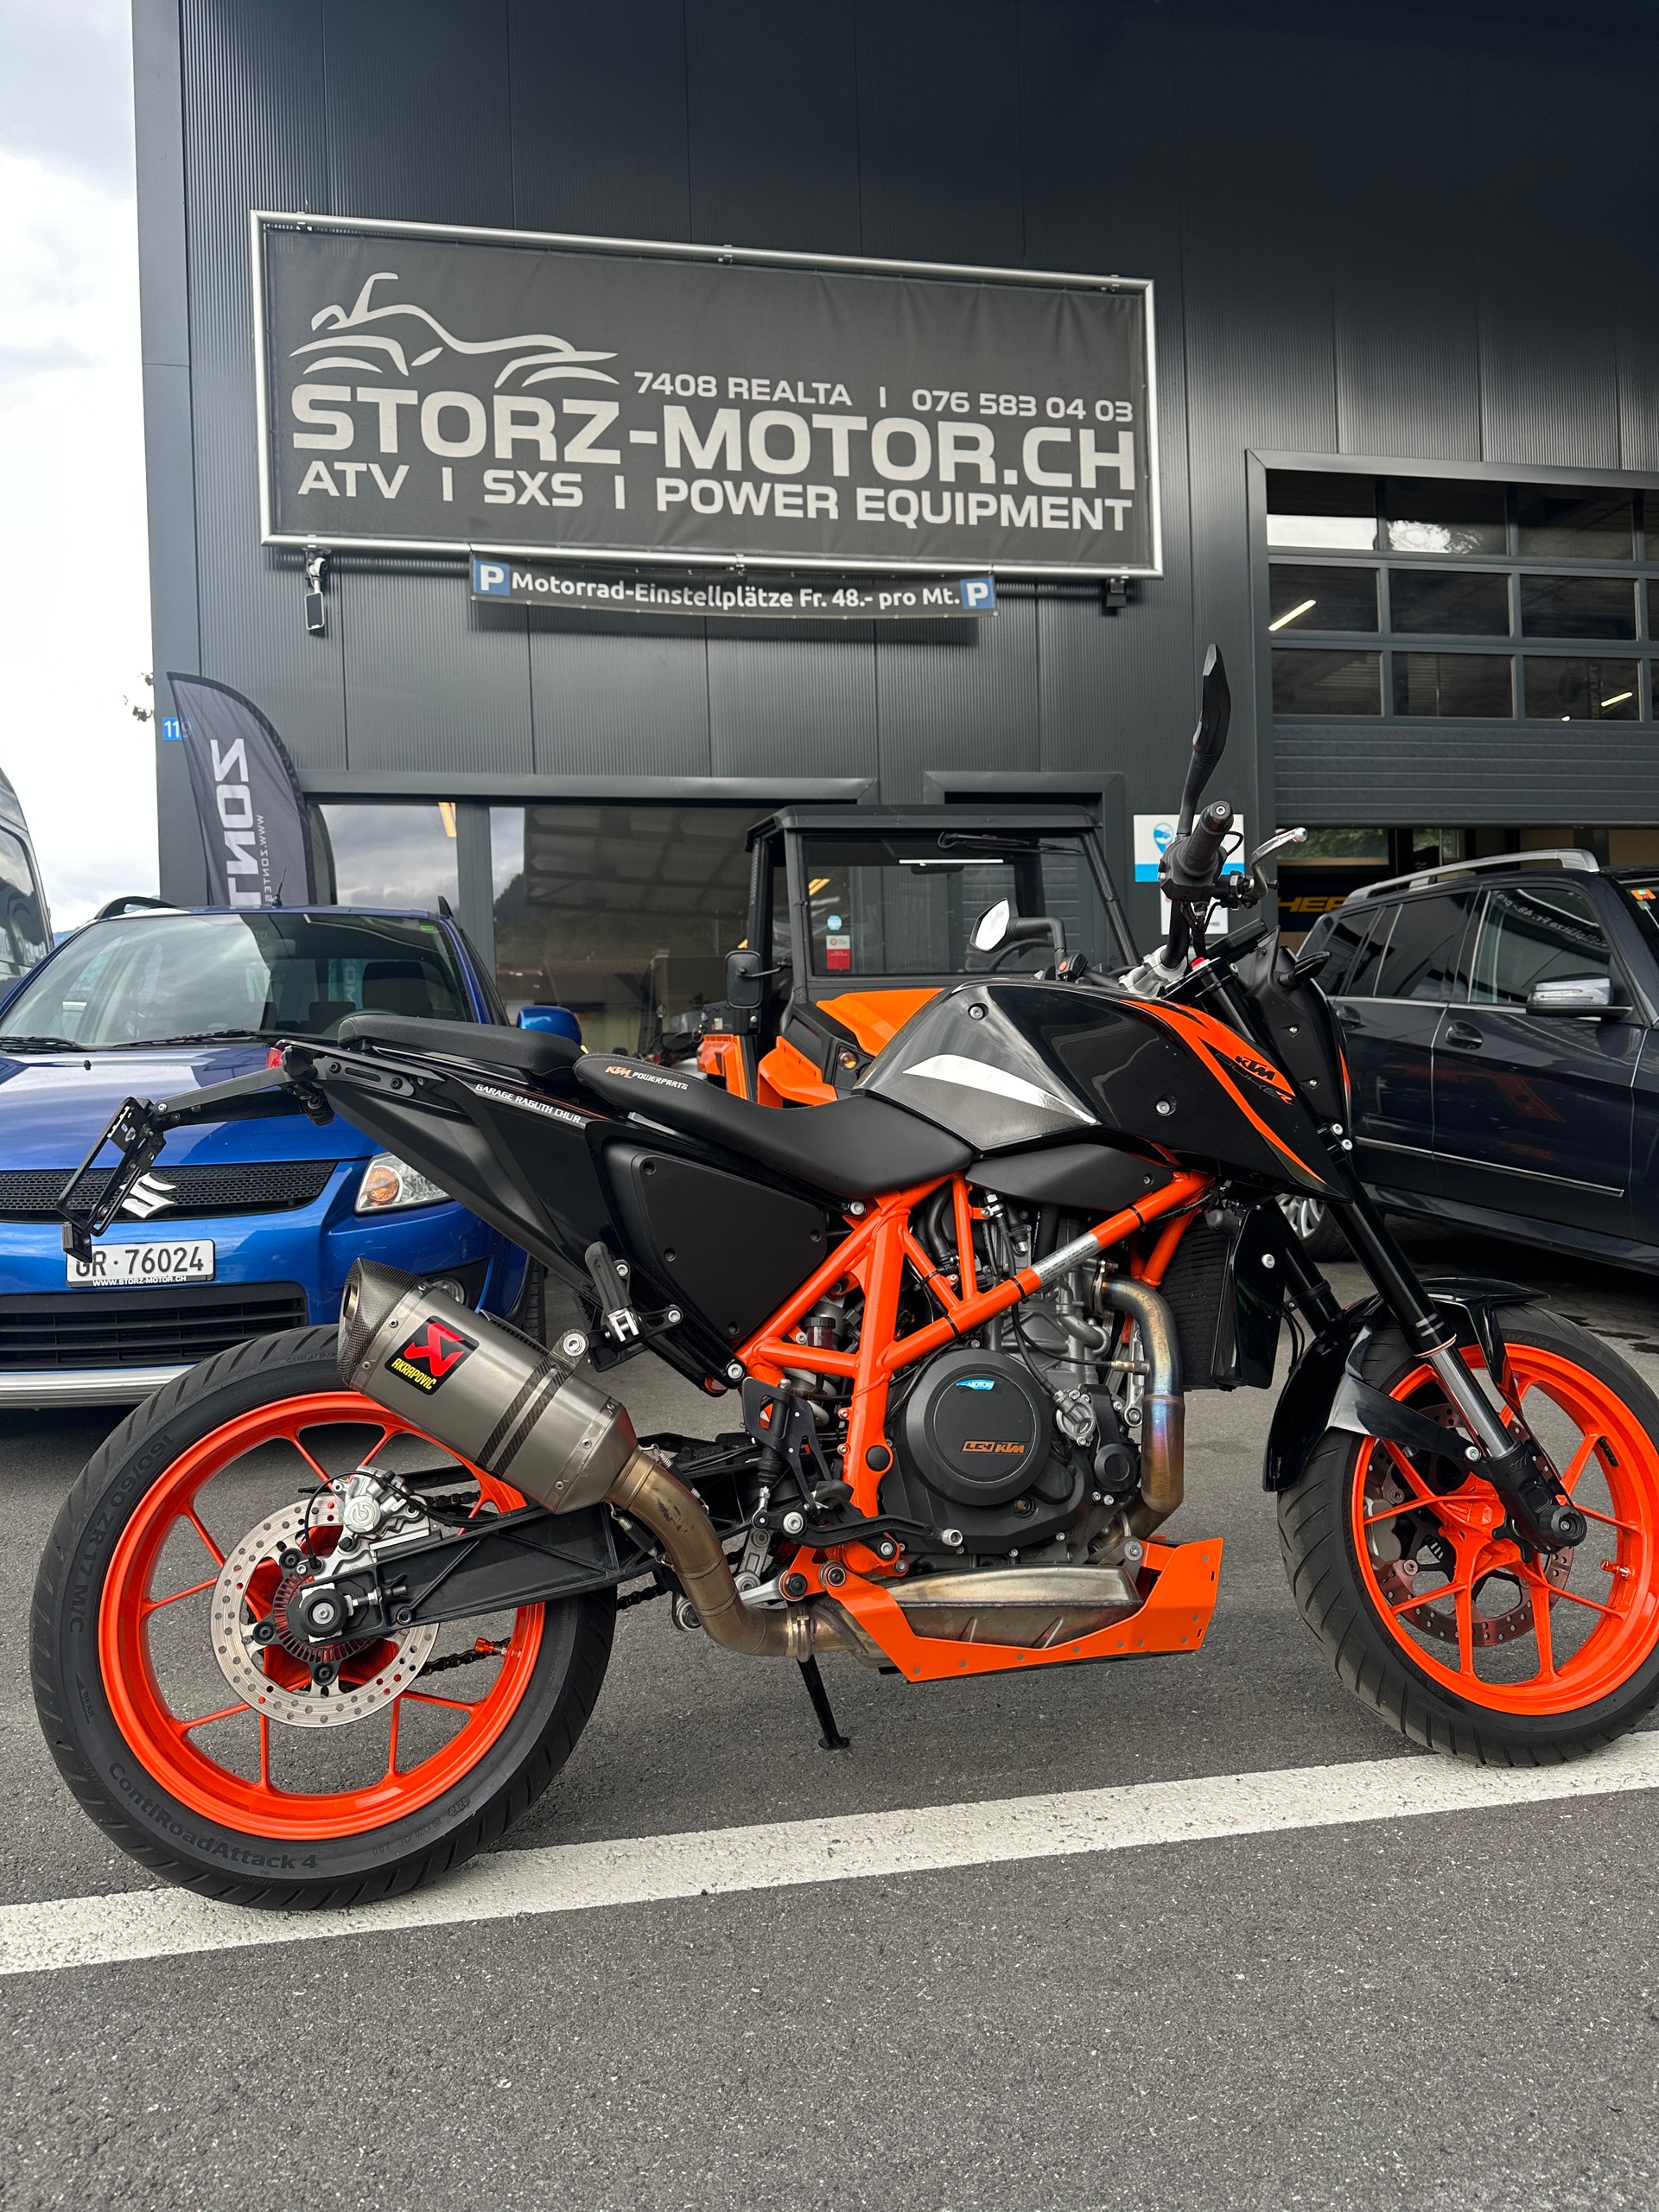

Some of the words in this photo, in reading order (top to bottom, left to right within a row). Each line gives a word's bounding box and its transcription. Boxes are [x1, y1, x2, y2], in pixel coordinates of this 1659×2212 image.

[634, 371, 717, 397] 7408
[728, 377, 853, 406] REALTA
[912, 388, 969, 414] 076
[979, 392, 1037, 416] 583
[1046, 397, 1086, 420] 04
[1094, 400, 1133, 422] 03
[291, 383, 1136, 490] STORZ-MOTOR.CH
[297, 461, 410, 499] ATV
[483, 469, 584, 507] SXS
[657, 477, 839, 520] POWER
[855, 487, 1133, 531] EQUIPMENT
[480, 564, 505, 591] P
[512, 571, 794, 611] Motorrad-Einstellplätze
[799, 588, 828, 607] Fr.
[831, 588, 874, 607] 48.-
[879, 591, 917, 609] pro
[923, 588, 961, 605] Mt.
[966, 582, 989, 606] P
[605, 1065, 632, 1079] KTM
[632, 1071, 689, 1090] POWERPARTS
[1235, 1055, 1276, 1081] KTM
[475, 1084, 515, 1102] GARAGE
[515, 1096, 554, 1115] RAGUTH
[554, 1108, 582, 1124] CHUR
[92, 1275, 187, 1287] WWW.STORZ-MOTOR.CH
[125, 1246, 204, 1274] 76024
[995, 1441, 1025, 1453] KTM
[111, 1434, 175, 1509] 160/60
[69, 1584, 89, 1634] M/C
[109, 1762, 296, 1870] ContiRoadAttack
[301, 1853, 318, 1869] 4
